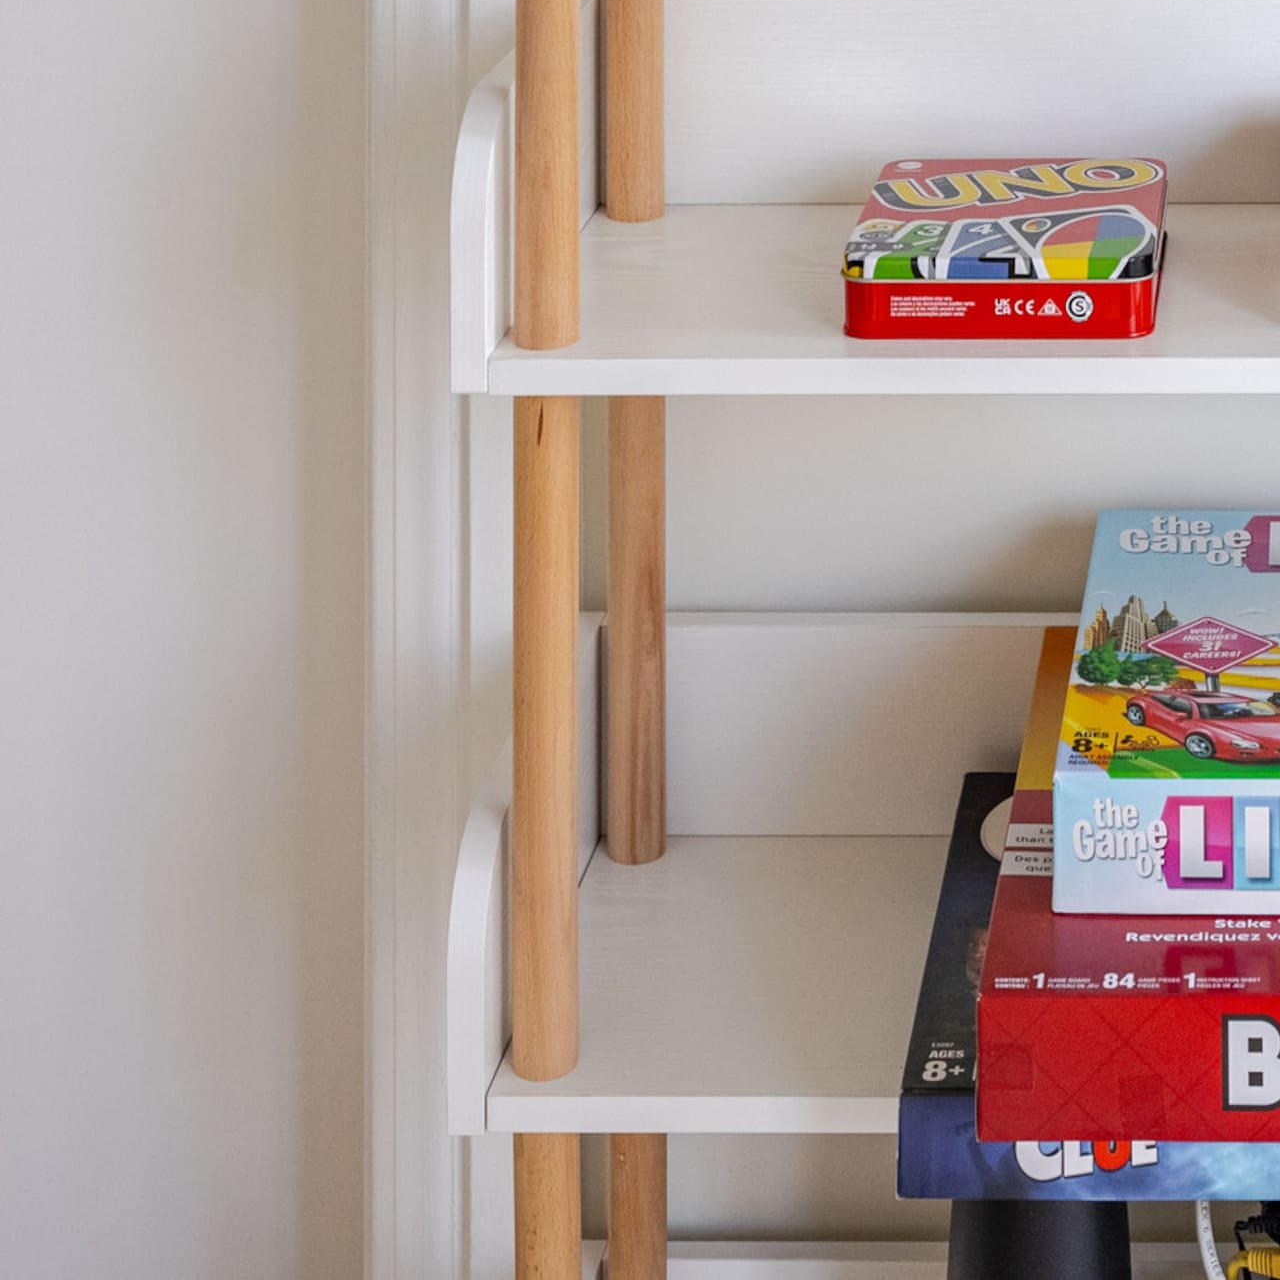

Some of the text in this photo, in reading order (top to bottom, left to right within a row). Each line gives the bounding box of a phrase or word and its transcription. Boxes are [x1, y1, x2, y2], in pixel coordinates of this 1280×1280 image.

[873, 159, 1160, 212] UNO
[916, 225, 943, 237] 3
[968, 223, 993, 235] 4
[1150, 515, 1214, 537] the
[1119, 527, 1252, 556] Game
[1206, 546, 1247, 568] of
[1182, 633, 1238, 641] INCLUDES
[1190, 627, 1225, 635] WOW!
[1183, 650, 1241, 659] CAREERS!
[1199, 641, 1222, 651] 31
[1072, 739, 1108, 752] 8+
[1093, 797, 1139, 828] the
[1072, 819, 1168, 862] Game
[1136, 850, 1165, 880] of
[1214, 919, 1272, 929] Stake
[1126, 931, 1261, 942] Revendiquez
[1032, 972, 1045, 989] 1
[1103, 972, 1135, 989] 84
[1183, 972, 1196, 989] 1
[929, 1050, 965, 1058] AGES
[922, 1060, 965, 1081] 8+
